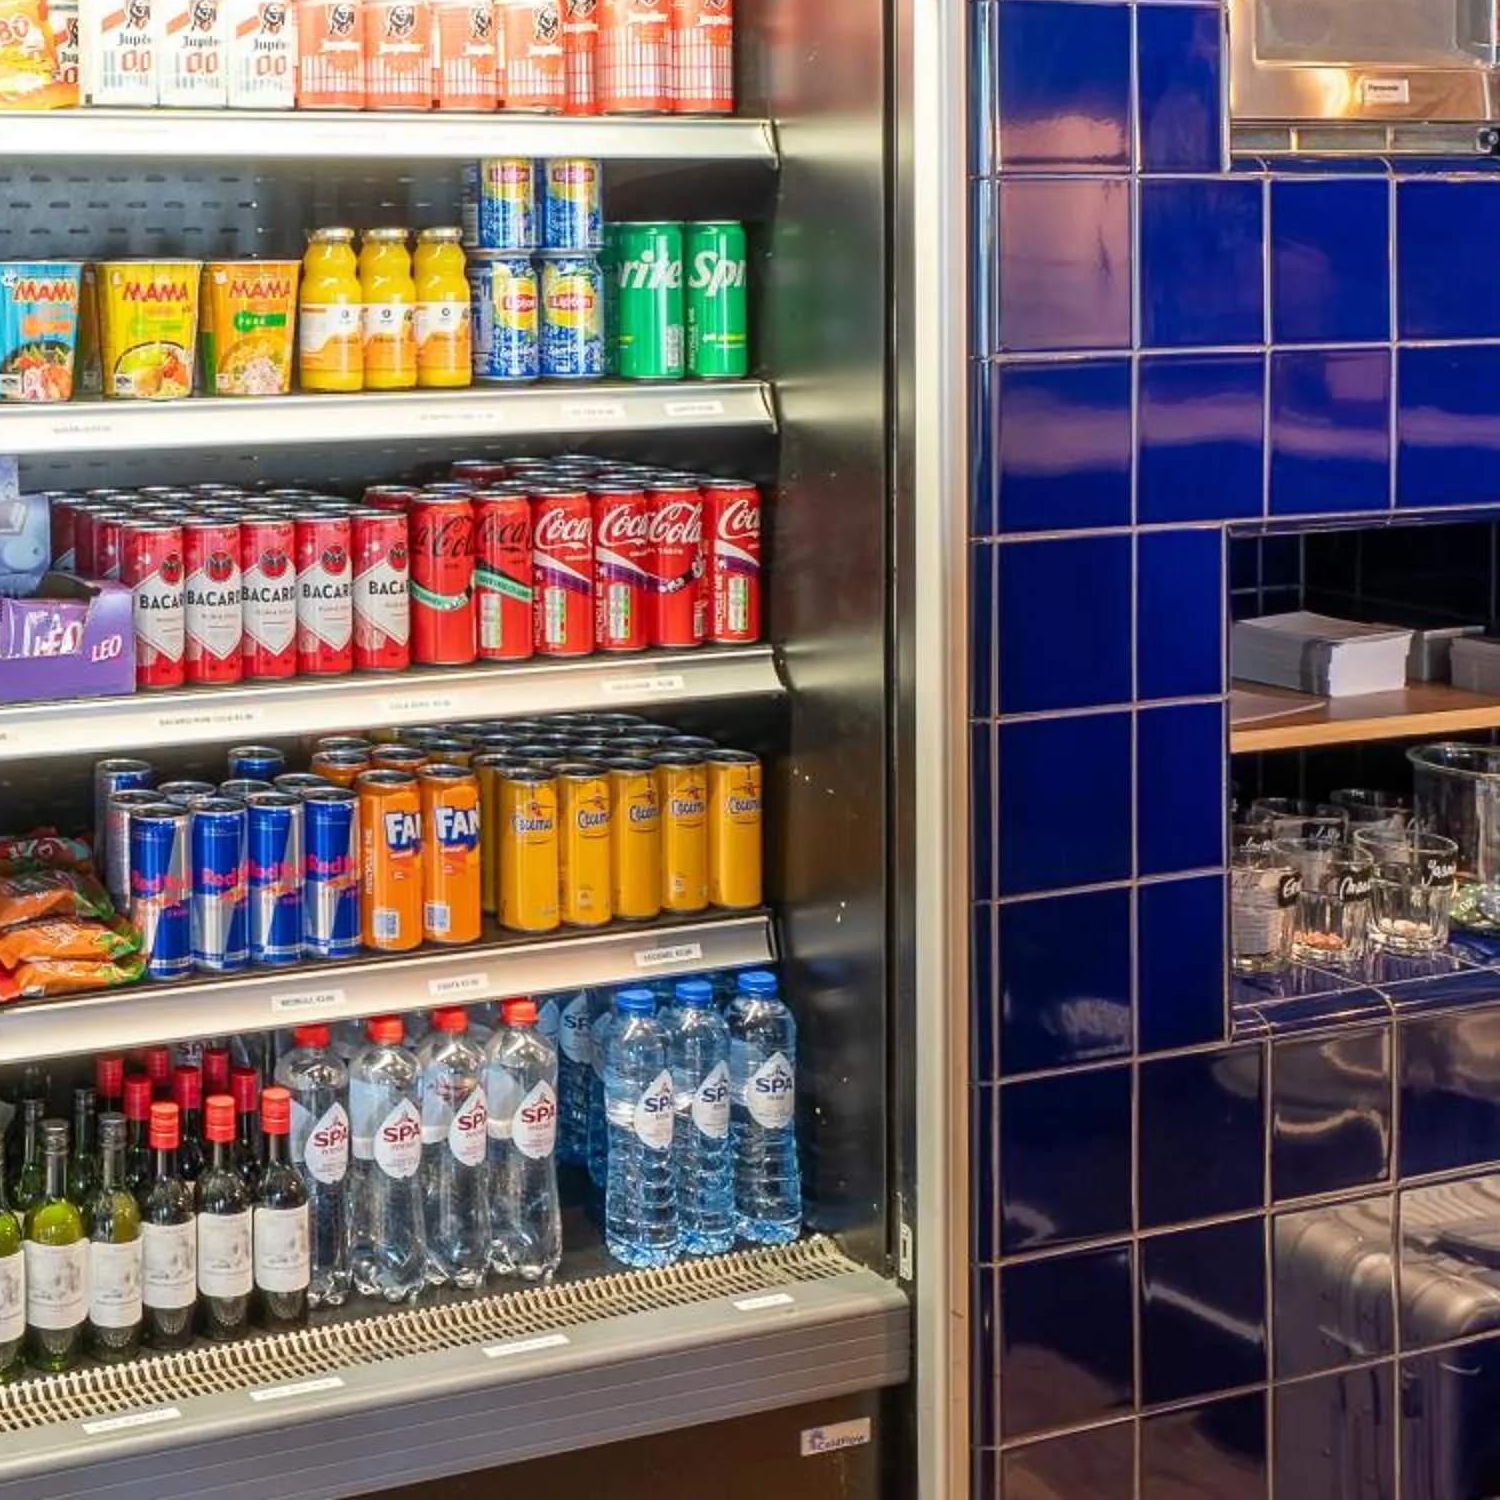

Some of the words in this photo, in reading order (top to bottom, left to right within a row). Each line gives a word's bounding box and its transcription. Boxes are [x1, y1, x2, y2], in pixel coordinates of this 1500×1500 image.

[124, 281, 188, 302] MAMA
[229, 280, 291, 300] MAMA
[91, 636, 122, 663] LEO
[755, 1075, 793, 1094] SPA
[383, 1122, 421, 1145] SPA
